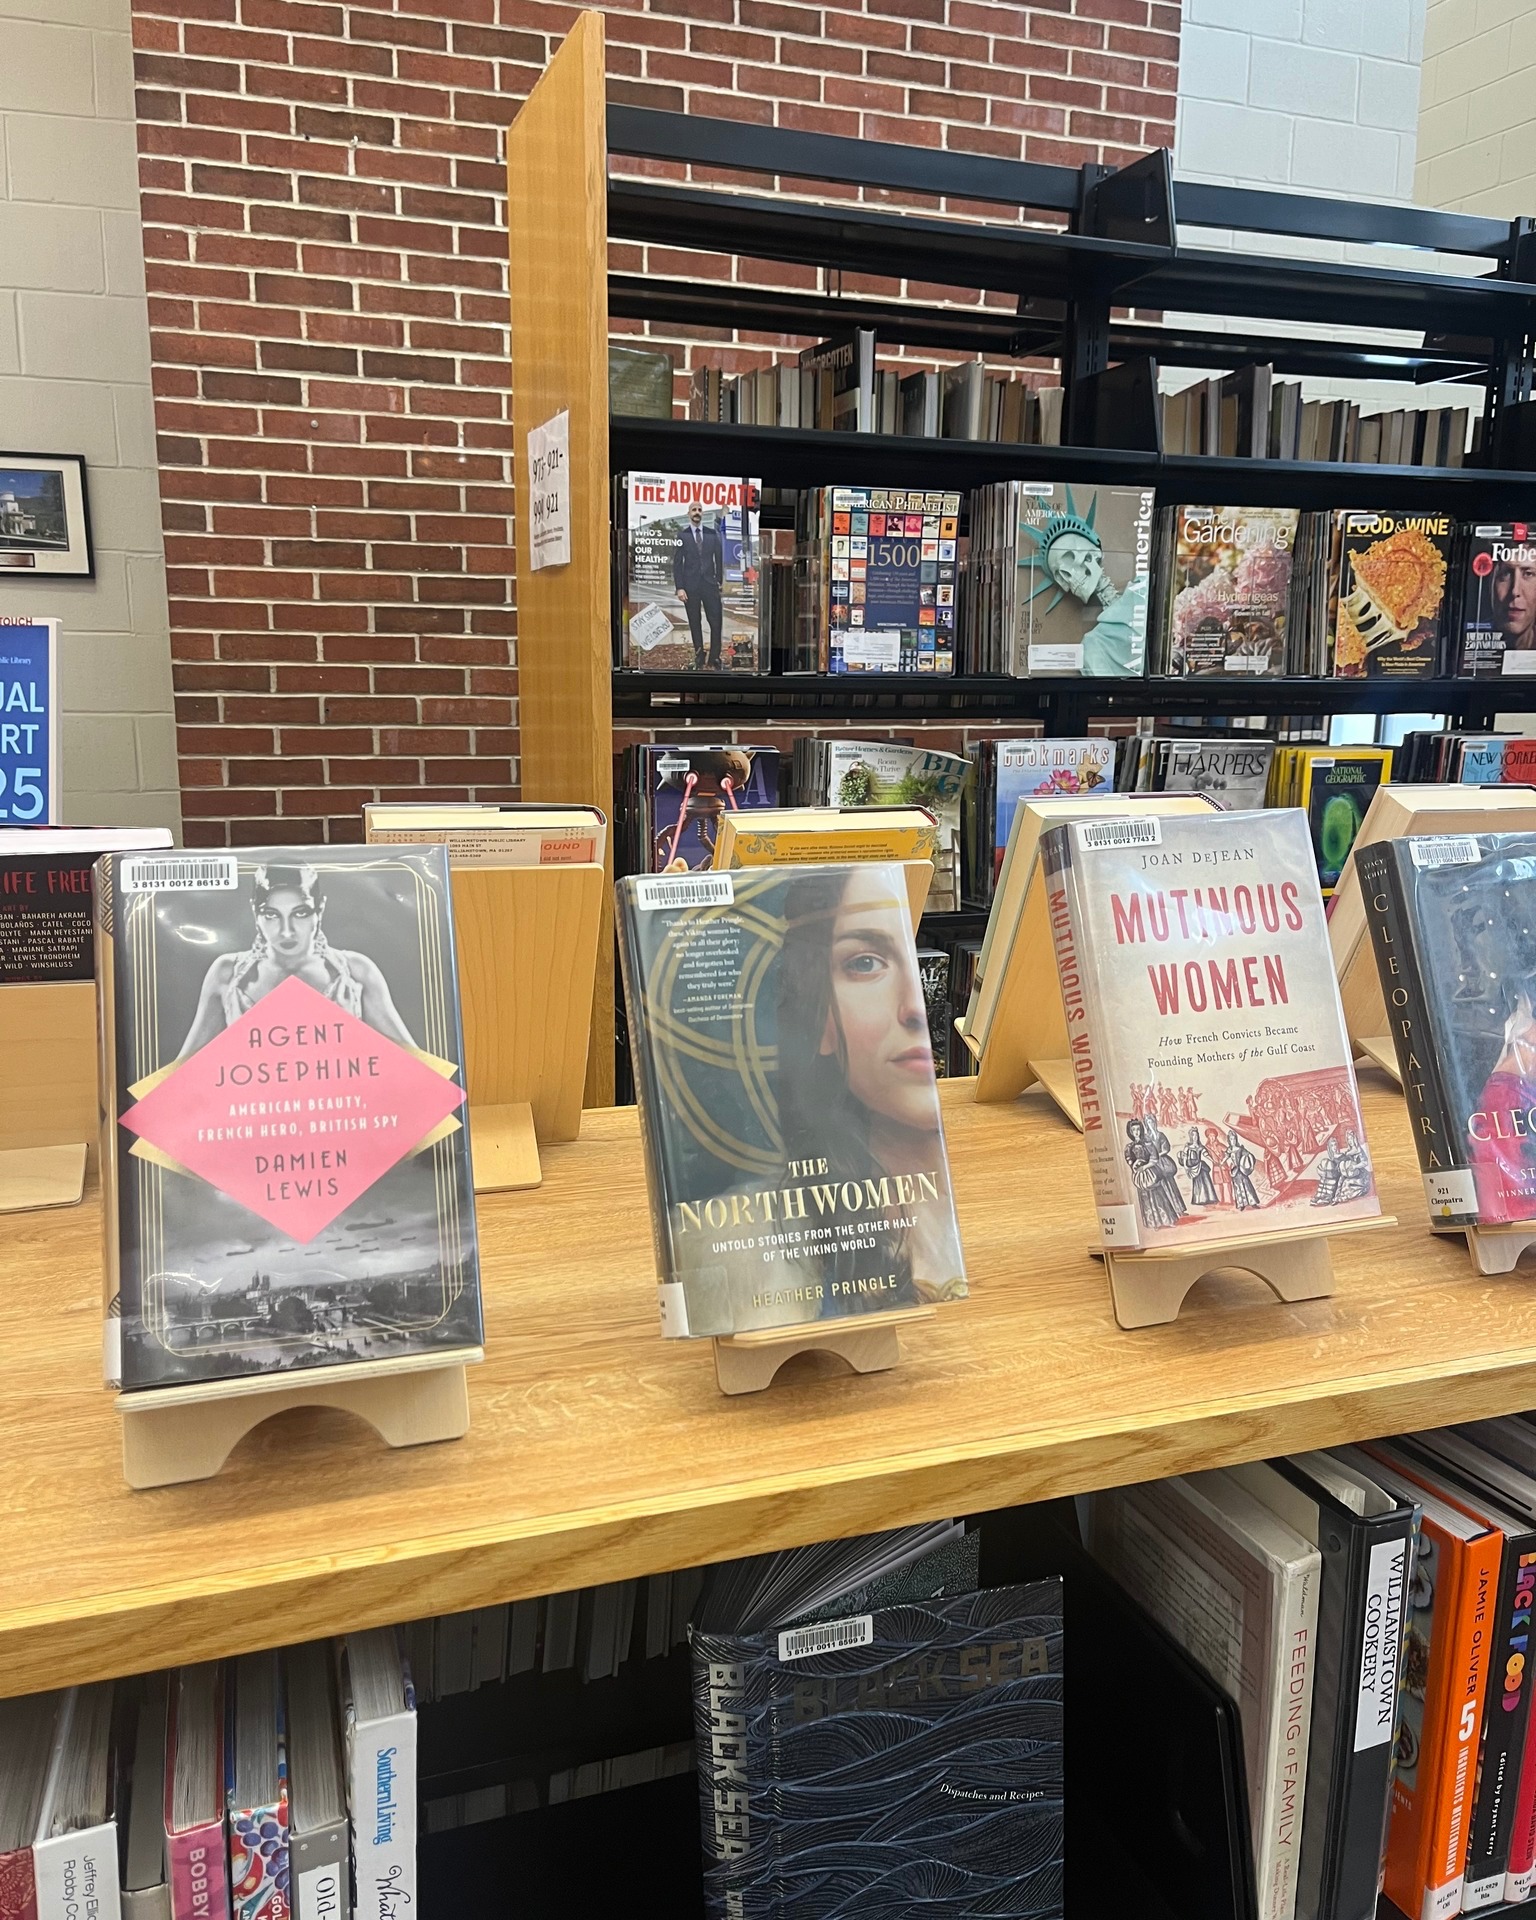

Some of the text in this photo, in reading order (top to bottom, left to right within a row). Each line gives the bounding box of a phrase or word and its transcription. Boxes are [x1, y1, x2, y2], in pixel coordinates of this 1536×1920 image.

[668, 481, 756, 508] ADVOCATE
[895, 496, 957, 513] PHILATELIST
[1183, 518, 1292, 549] Gardening
[1405, 517, 1450, 536] WINE
[635, 537, 684, 547] PROTECTING
[635, 546, 653, 554] OUR
[868, 543, 920, 568] 1500
[635, 555, 668, 564] HEALTH?
[1003, 744, 1110, 767] bookmarks
[1172, 751, 1267, 776] HARPER'S
[1471, 751, 1496, 766] NEW
[1325, 773, 1367, 784] GEOGRAPHIC
[1331, 766, 1363, 776] NATIONAL
[1141, 852, 1184, 870] JOAN
[142, 880, 165, 888] 8131
[197, 879, 220, 887] 8613
[21, 912, 56, 920] BAHAREH
[1110, 881, 1304, 945] MUTINOUS
[685, 929, 706, 937] Viking
[705, 948, 739, 956] overlooked
[1147, 954, 1290, 1016] WOMEN
[1049, 888, 1085, 1023] MUTINOUS
[1071, 1032, 1103, 1131] WOMEN
[248, 1022, 345, 1049] AGENT
[1158, 1024, 1299, 1047] How French Convicts Became
[1147, 1042, 1316, 1069] Founding Mothers of the Gulf Coast
[215, 1055, 380, 1088] JOSEPHINE
[228, 1095, 368, 1117] AMERICAN BEAUTY,
[197, 1114, 400, 1143] FRENCH HERO, BRITISH SPY
[255, 1149, 348, 1175] DAMIEN
[788, 1157, 829, 1179] THE
[266, 1177, 340, 1202] LEWIS
[1430, 1195, 1463, 1205] Cleopatra
[1437, 1187, 1449, 1195] 921
[675, 1171, 940, 1236] NORTHWOMEN
[712, 1216, 919, 1254] UNTOLD STORIES FROM THE OTHER HALF
[763, 1237, 876, 1263] OF THE VIKING WORLD
[752, 1274, 898, 1308] HEATHER PRINGLE
[794, 1646, 814, 1655] 8131
[816, 1641, 836, 1650] 0011
[838, 1637, 858, 1646] 8599
[1361, 1594, 1382, 1693] COOKERY
[1377, 1551, 1405, 1727] WILLIAMSTOWN
[1466, 1568, 1490, 1697] JAMIE OLIVER
[1286, 1628, 1308, 1742] FEEDING
[1502, 1633, 1528, 1712] FOOD
[709, 1663, 748, 1782] BLACK
[1458, 1699, 1476, 1742] 5
[1453, 1746, 1469, 1805] INGREDIENTS
[372, 1747, 398, 1846] Southern Living
[940, 1783, 1045, 1802] Dispatches and Recipes
[1278, 1762, 1298, 1847] FAMILY
[1486, 1752, 1507, 1856] Edited by Bryant Terry
[713, 1788, 750, 1861] SEA
[63, 1859, 77, 1901] Robby
[82, 1855, 97, 1899] Jeffrey
[190, 1848, 209, 1918] BOBBY
